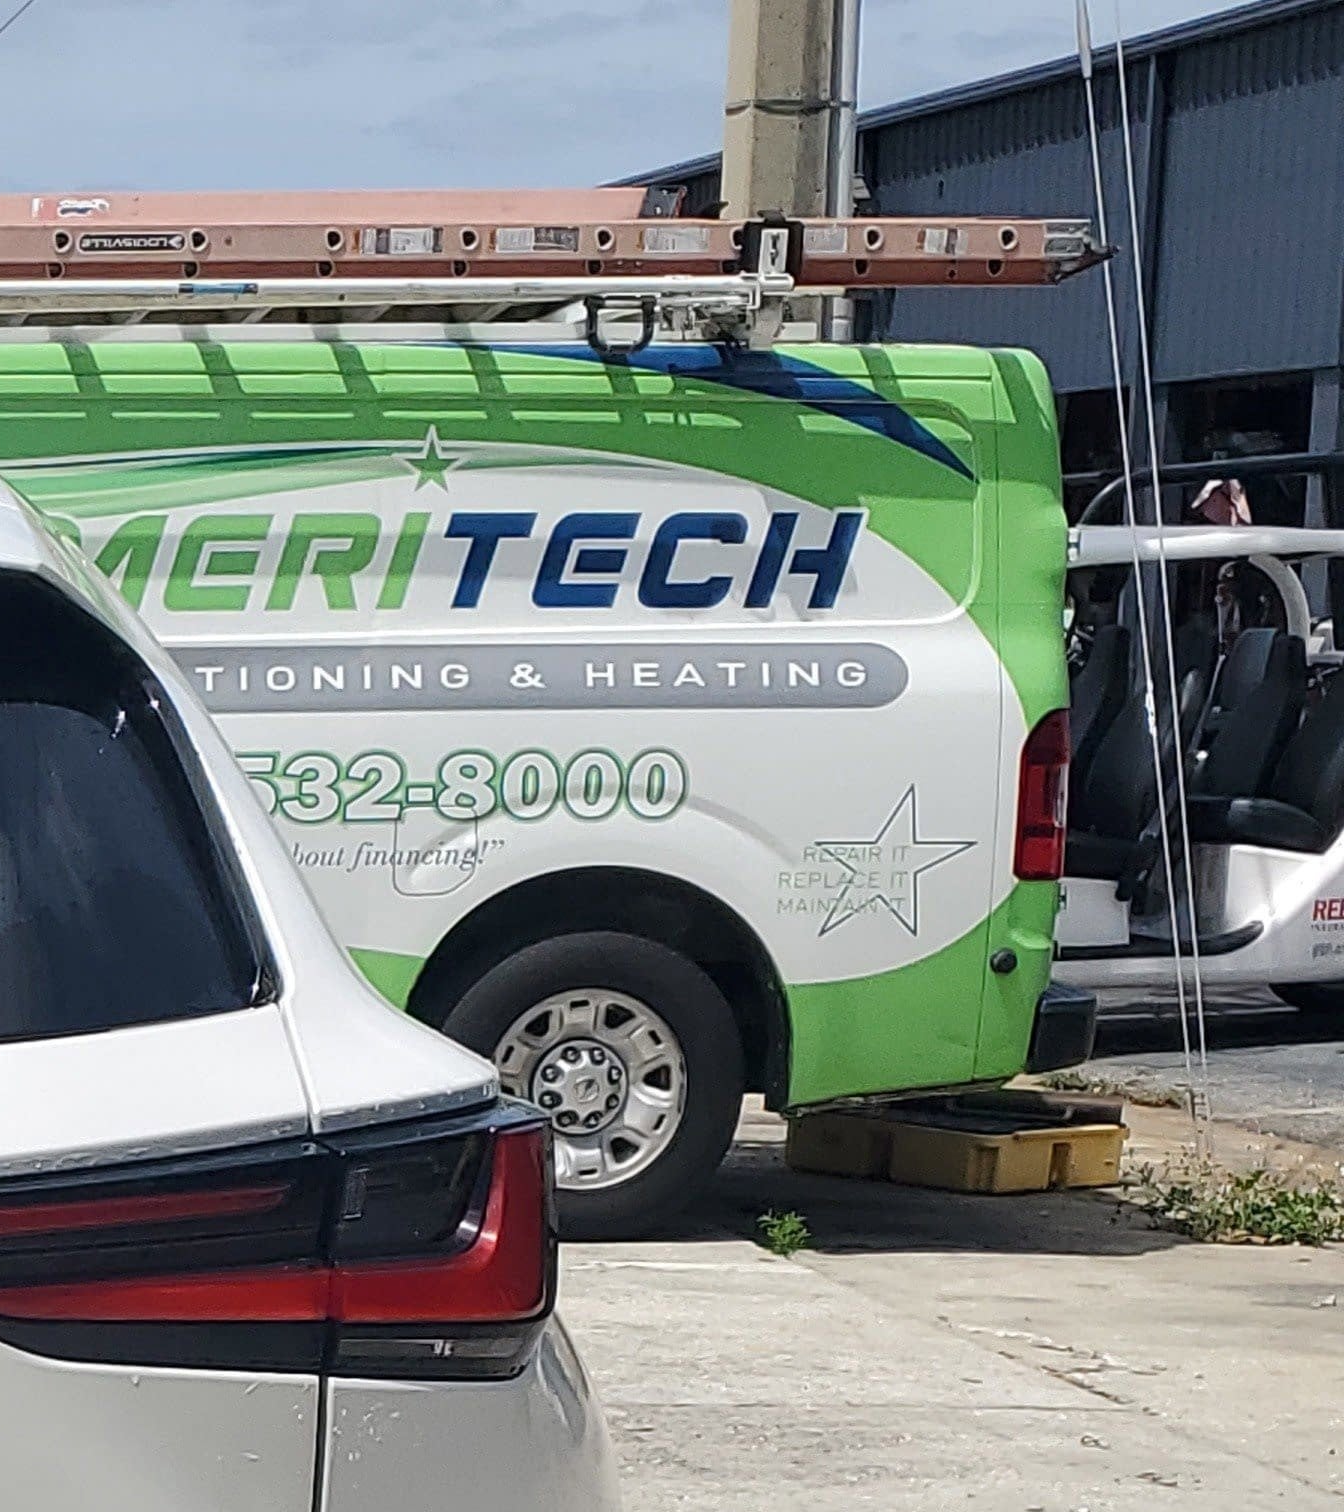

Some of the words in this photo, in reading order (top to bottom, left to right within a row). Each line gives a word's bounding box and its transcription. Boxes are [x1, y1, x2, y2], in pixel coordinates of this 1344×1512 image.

[81, 237, 168, 248] LOUISVILLE
[195, 664, 470, 691] TIONING
[510, 663, 545, 688] &
[586, 661, 868, 688] HEATING
[234, 749, 688, 823] 532-8000
[803, 846, 882, 863] REPAIR
[892, 846, 909, 862] IT
[778, 871, 881, 889] REPLACE
[890, 871, 907, 888] IT
[777, 898, 878, 914] MAINTAIN
